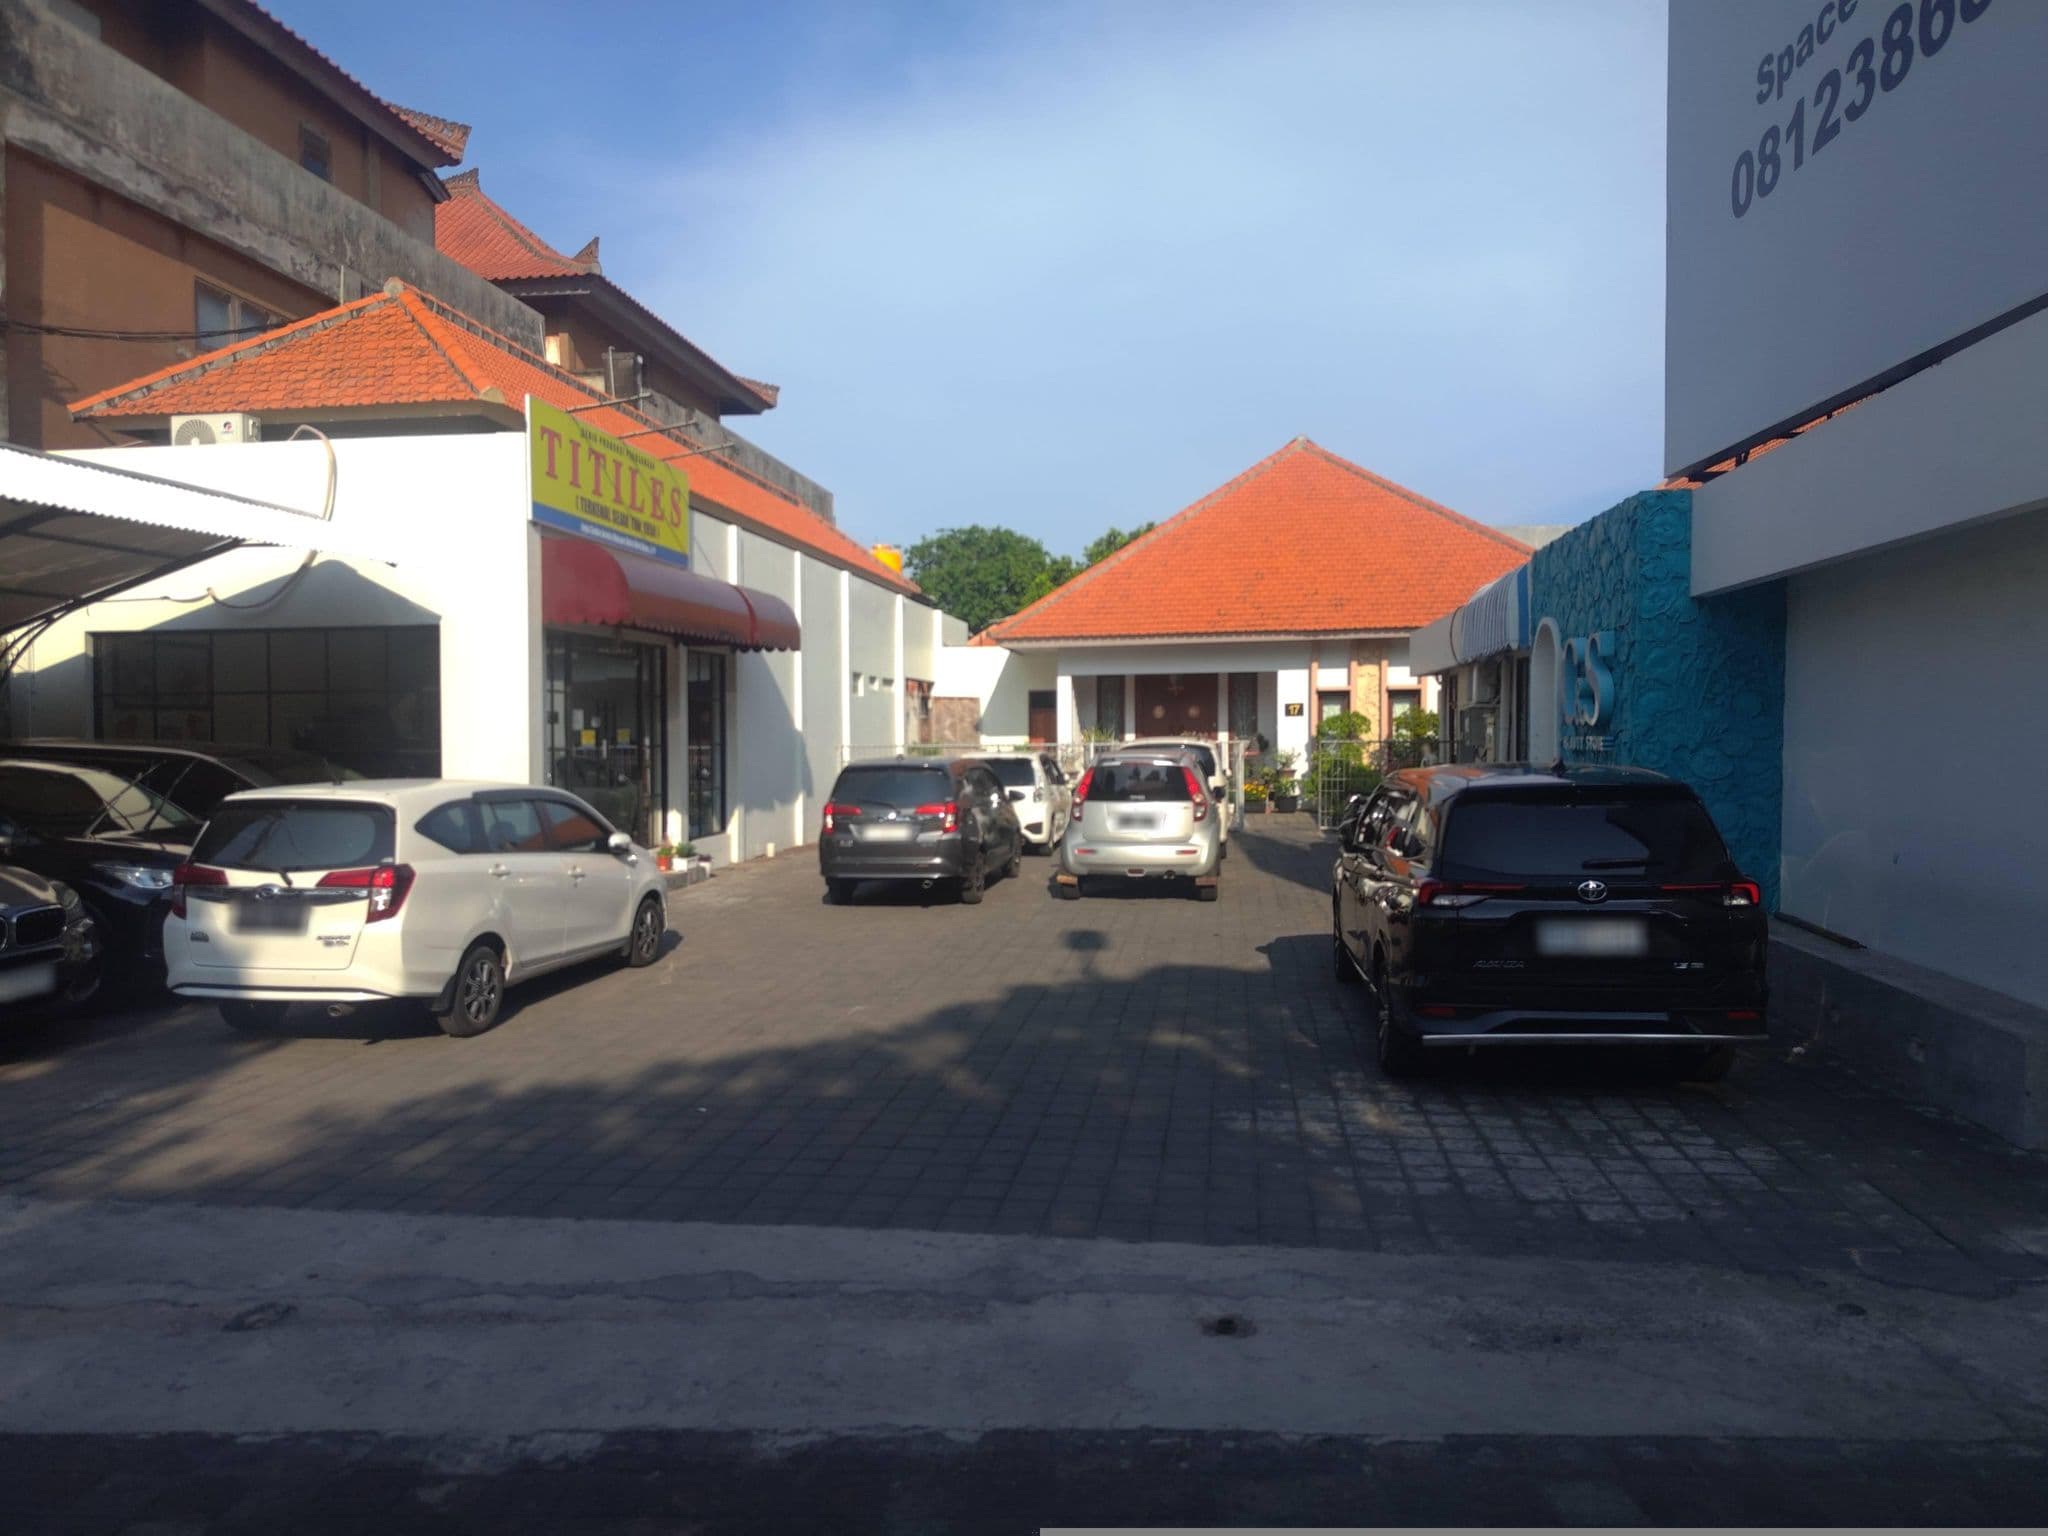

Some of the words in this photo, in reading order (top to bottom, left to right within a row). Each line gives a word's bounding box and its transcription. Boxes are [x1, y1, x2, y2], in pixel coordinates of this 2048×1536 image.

[1731, 0, 1994, 219] 0812386
[540, 425, 681, 528] TITILES
[1288, 704, 1300, 715] 17
